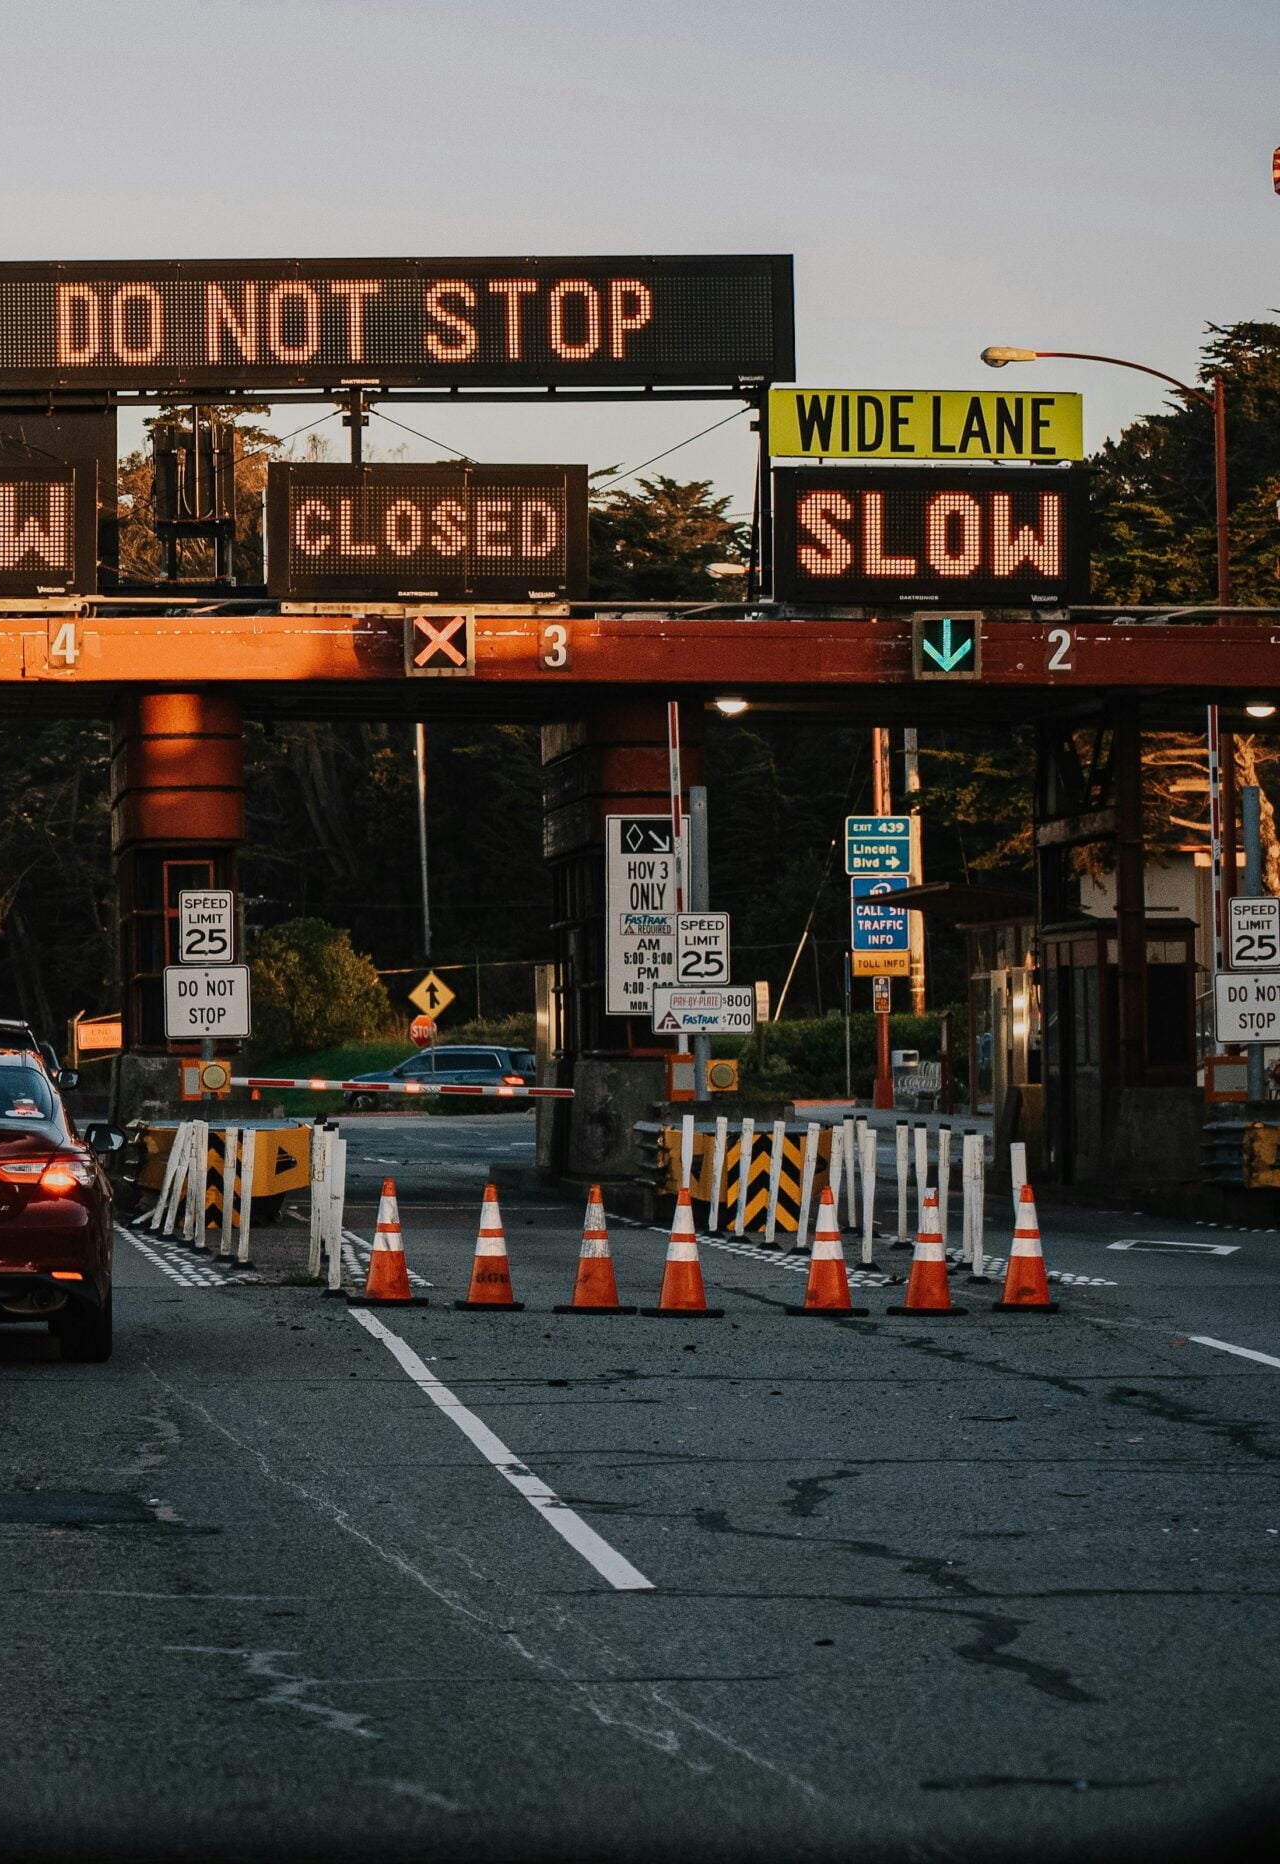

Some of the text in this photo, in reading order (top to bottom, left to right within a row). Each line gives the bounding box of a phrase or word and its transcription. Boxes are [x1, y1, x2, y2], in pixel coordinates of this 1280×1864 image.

[58, 279, 654, 364] DO NOT STOP
[795, 394, 1057, 455] WIDE LANE
[295, 499, 557, 558] CLOSED
[799, 492, 1060, 577] SLOW
[51, 623, 80, 665] 4
[543, 624, 567, 667] 3
[1048, 628, 1072, 671] 2
[853, 822, 905, 833] EXIT 439
[853, 844, 898, 855] Lincoln
[853, 857, 880, 868] Blvd
[627, 861, 669, 880] HOV 3
[184, 898, 228, 909] SPEED
[629, 883, 667, 911] ONLY
[856, 905, 884, 916] CALL
[1233, 904, 1277, 916] SPEED
[188, 913, 224, 924] LIMIT
[637, 924, 672, 934] REQUIRED
[680, 920, 725, 931] SPEED
[857, 920, 904, 931] TRAFFIC
[1237, 920, 1273, 931] LIMIT
[185, 928, 228, 955] 25
[637, 938, 660, 951] AM
[684, 935, 720, 946] LIMIT
[868, 934, 894, 945] INFO
[1235, 934, 1277, 961] 25
[623, 952, 644, 965] 5:00
[652, 952, 673, 965] 9:00
[681, 950, 724, 977] 25
[858, 959, 905, 968] TOLL INFO
[637, 966, 659, 979] PM
[178, 979, 235, 997] DO NOT
[623, 981, 644, 994] 4:00
[1228, 986, 1248, 1002] DO
[629, 1001, 649, 1011] MON
[672, 996, 719, 1007] PAY-BY-PLATE
[188, 1007, 227, 1024] STOP
[1238, 1012, 1276, 1029] STOP
